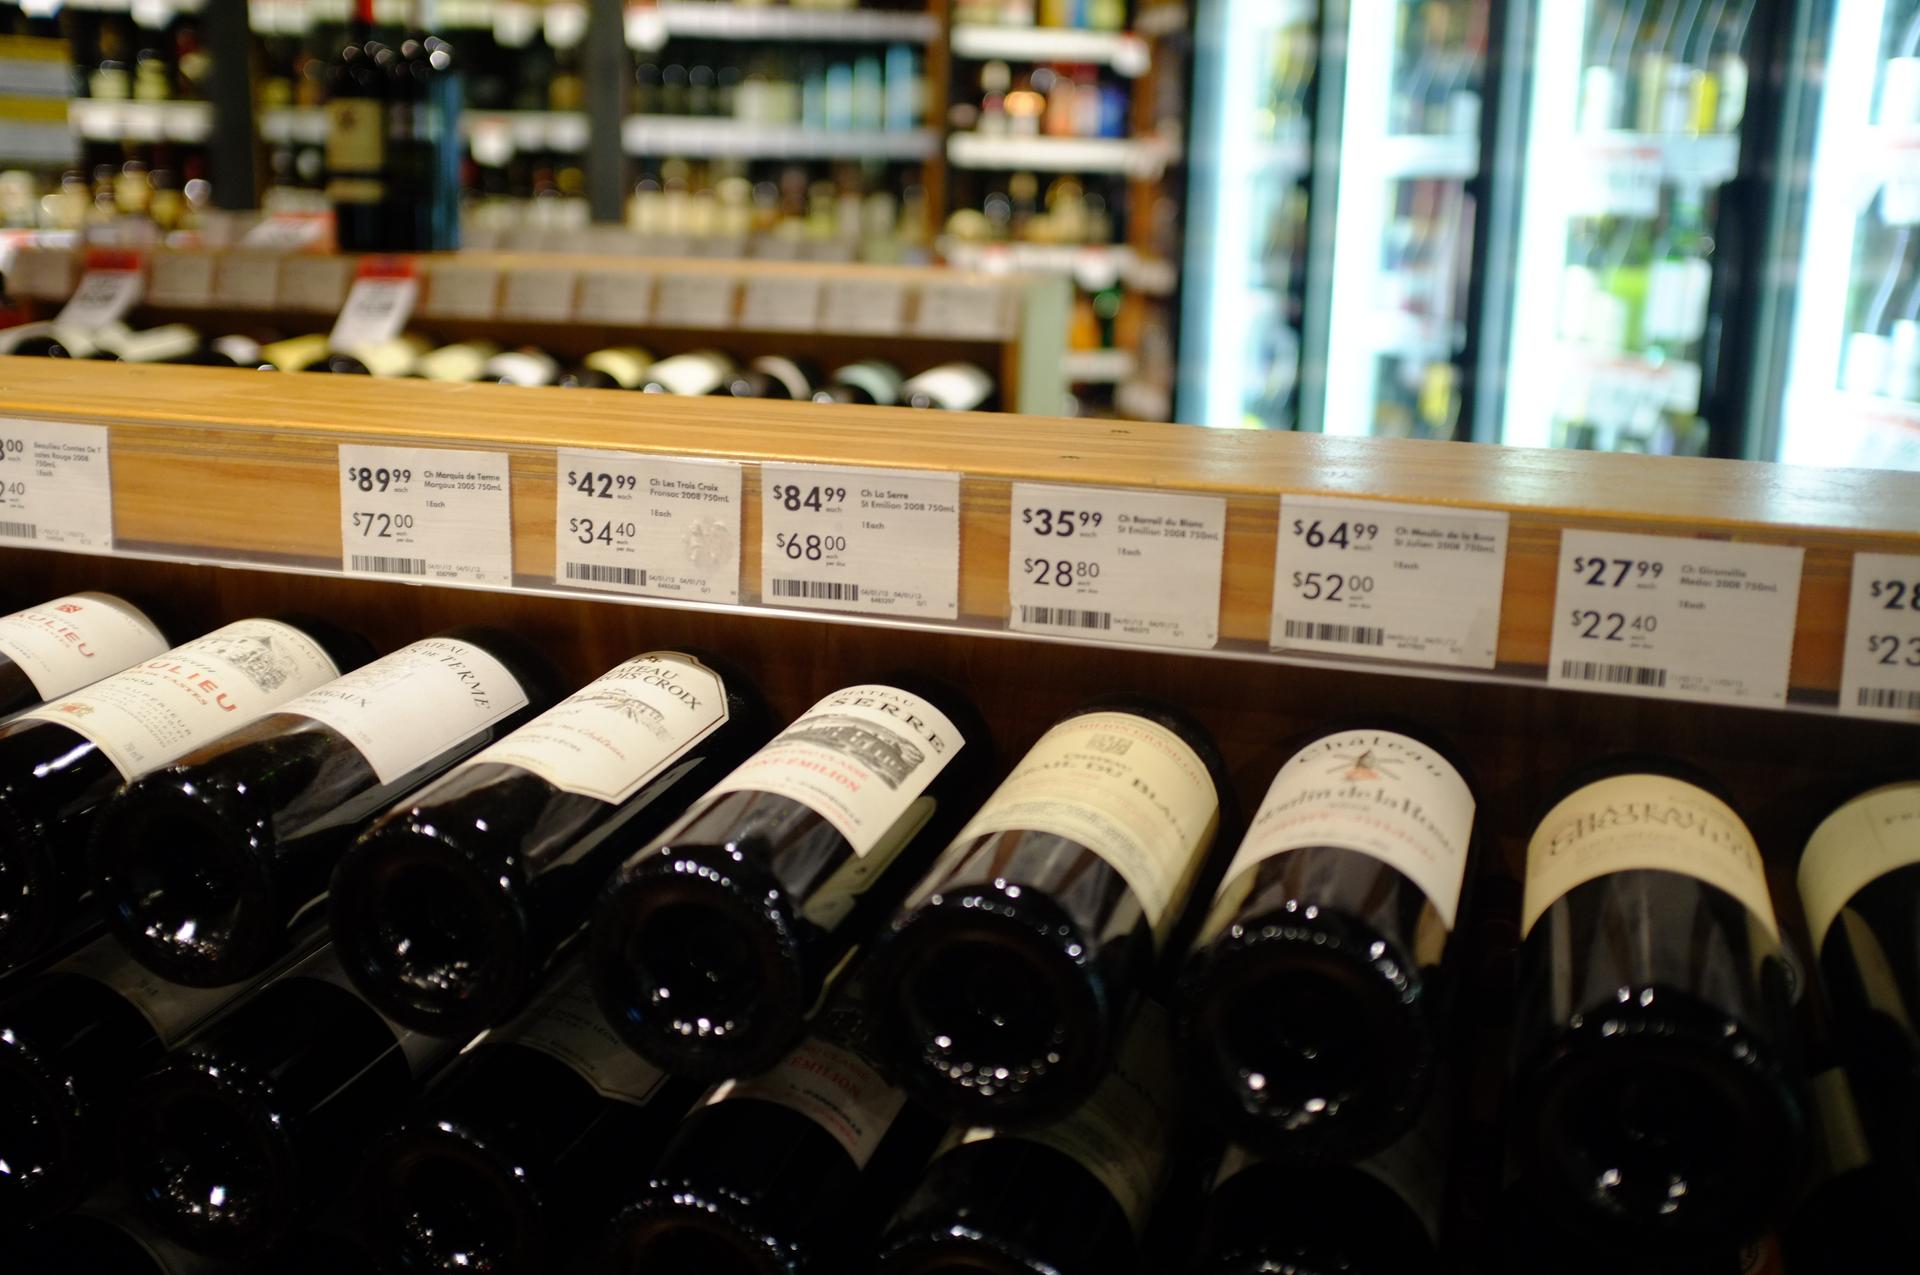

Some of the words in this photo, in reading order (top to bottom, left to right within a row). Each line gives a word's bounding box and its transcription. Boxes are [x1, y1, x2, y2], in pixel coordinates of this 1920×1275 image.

[423, 470, 434, 478] Ch
[435, 472, 464, 480] Marquis
[466, 472, 475, 480] de
[423, 481, 455, 490] Margaux
[457, 482, 475, 490] 2005
[477, 483, 503, 491] 750mL
[649, 478, 660, 486] Ch
[662, 480, 675, 488] Les
[677, 480, 696, 489] Trois
[697, 482, 719, 491] Croix
[649, 488, 680, 498] Fronsac
[681, 491, 701, 500] 2008
[703, 493, 730, 503] 750mL
[861, 489, 873, 497] Ch
[874, 490, 885, 498] La
[886, 491, 909, 499] Serre
[871, 501, 902, 509] Emilion
[904, 502, 925, 511] 2008
[928, 504, 955, 513] 750mL
[1118, 514, 1130, 522] Ch
[1118, 525, 1126, 533] St
[1128, 526, 1161, 536] Emilion
[440, 656, 492, 710] TERME
[643, 675, 703, 711] CROIX
[829, 697, 946, 754] SERRE
